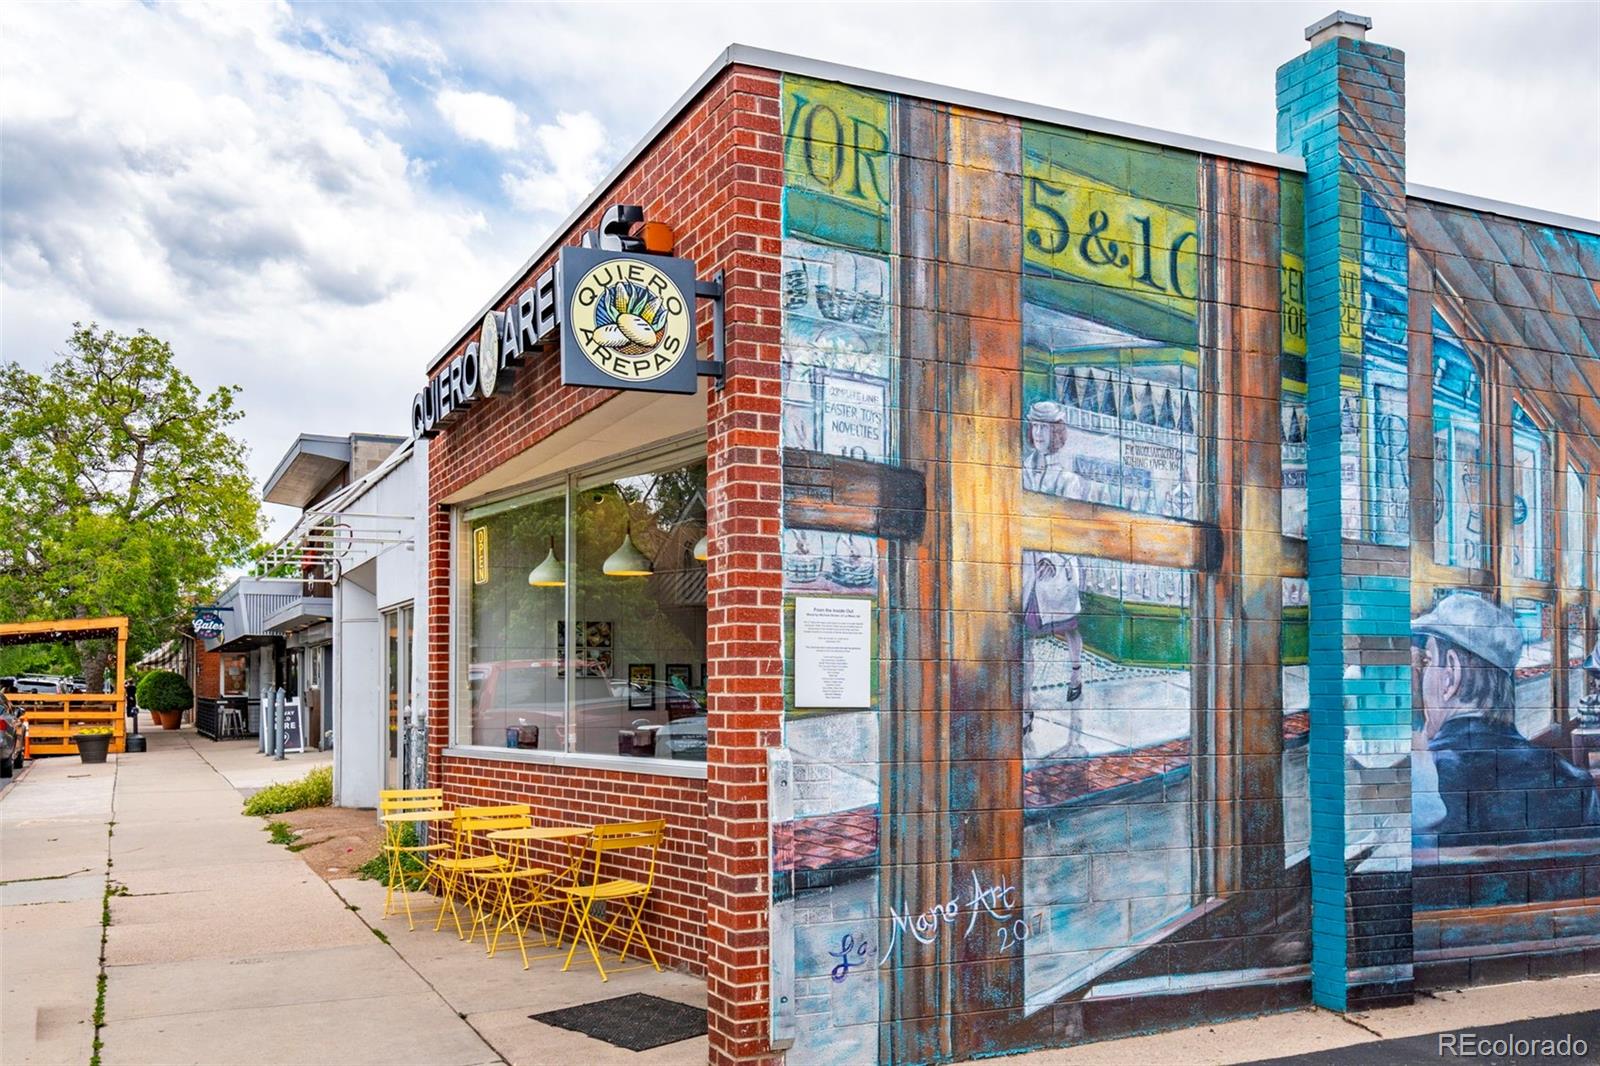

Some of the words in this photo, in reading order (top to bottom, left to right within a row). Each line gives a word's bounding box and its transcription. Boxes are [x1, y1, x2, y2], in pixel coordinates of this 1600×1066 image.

[580, 264, 682, 316] QUIERO
[580, 327, 680, 377] AREPAS
[411, 342, 478, 441] QUIERO
[825, 401, 858, 418] EASTER
[860, 408, 882, 425] TOYS
[832, 419, 880, 441] NOVELTIES
[879, 895, 960, 966] Mano
[963, 869, 1016, 939] Art
